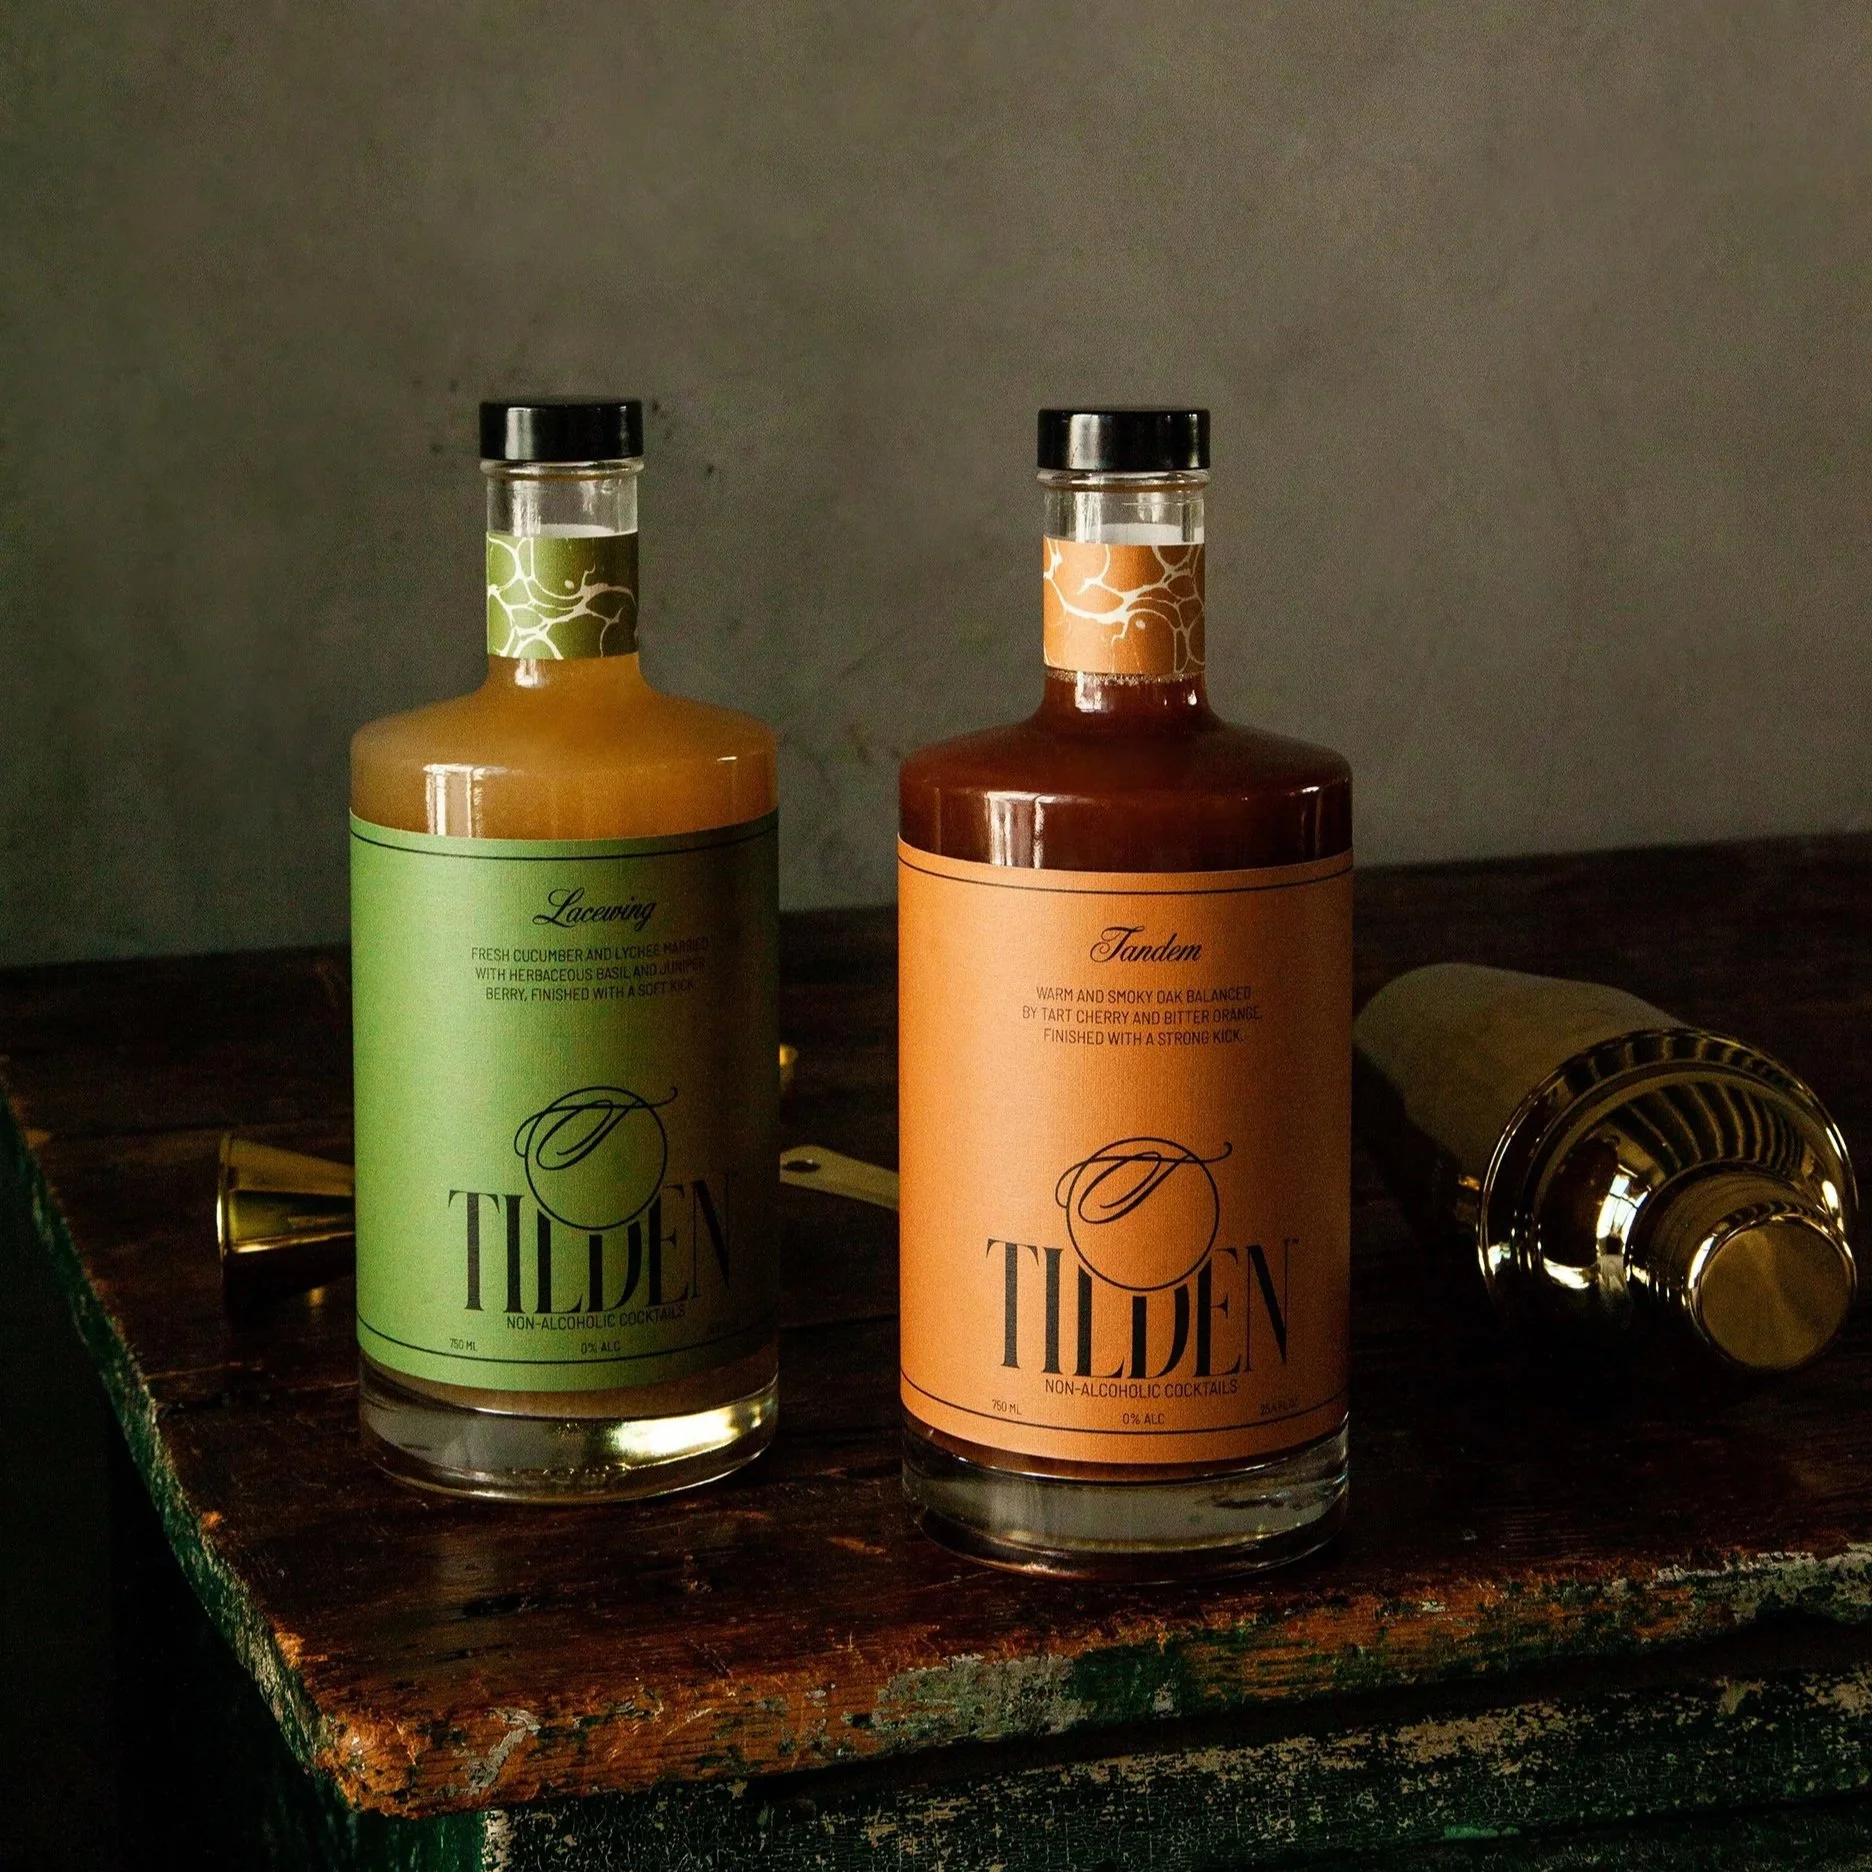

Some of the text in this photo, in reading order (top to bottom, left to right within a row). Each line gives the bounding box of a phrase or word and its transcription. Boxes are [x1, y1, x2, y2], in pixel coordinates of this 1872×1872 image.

[532, 887, 657, 932] Lacewing
[471, 937, 709, 962] FRESH CUCUMBER AND LYCHEE MARRIED
[1090, 925, 1202, 963] Tandem
[475, 957, 706, 982] WITH HERBACEOUS BASIL AND JUNIPER
[485, 987, 528, 1002] BERRY,
[531, 987, 589, 1001] FINISHED
[593, 985, 624, 1000] WITH
[628, 985, 636, 998] A
[638, 981, 668, 996] SOFT
[1036, 986, 1252, 1004] WARM AND SMOKY OAK BALANCED
[1022, 1006, 1037, 1019] BY
[1041, 1008, 1072, 1022] TART
[1077, 1010, 1129, 1025] CHERRY
[1133, 1011, 1160, 1025] AND
[1164, 1010, 1209, 1024] BITTER
[1044, 1029, 1104, 1046] FINISHED
[1108, 1031, 1141, 1046] WITH
[1146, 1032, 1154, 1045] A
[1158, 1031, 1209, 1046] STRONG
[448, 1172, 731, 1315] TILDEN
[986, 1238, 1290, 1378] TILDEN
[507, 1306, 686, 1331] NON-ALCOHOLIC COCKTAILS
[449, 1338, 478, 1352] 750 ML
[580, 1340, 621, 1355] 0% ALC
[1045, 1379, 1238, 1399] NON-ALCOHOLIC COCKTAILS
[991, 1400, 1022, 1415] 750 ML
[1122, 1413, 1165, 1425] 0% ALC
